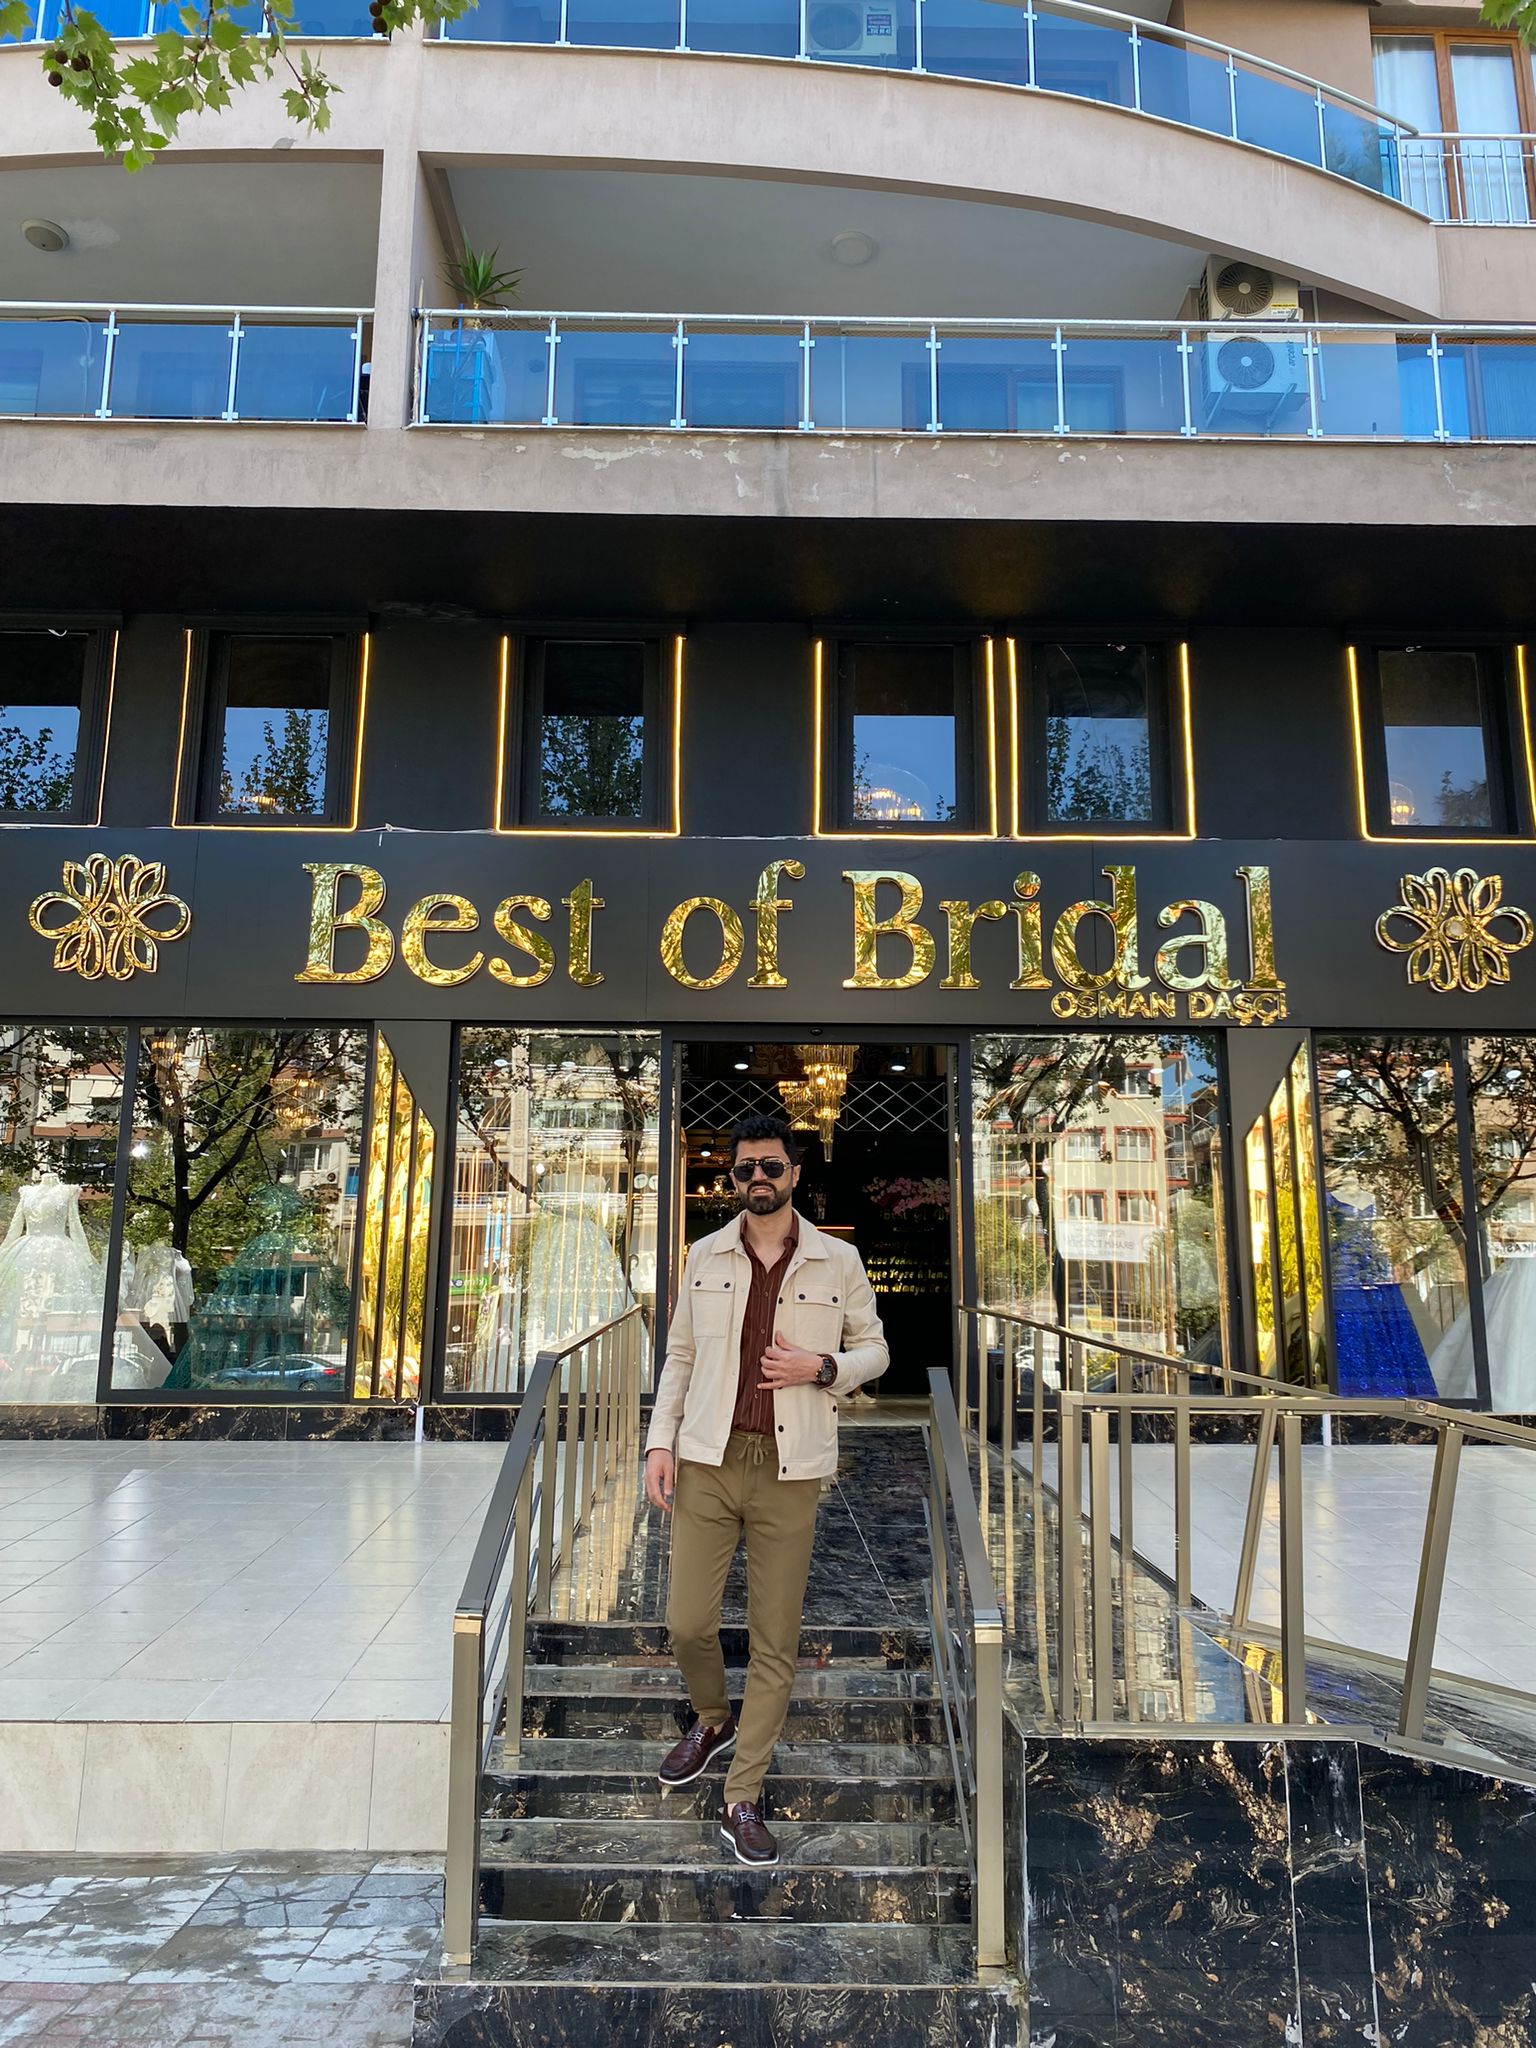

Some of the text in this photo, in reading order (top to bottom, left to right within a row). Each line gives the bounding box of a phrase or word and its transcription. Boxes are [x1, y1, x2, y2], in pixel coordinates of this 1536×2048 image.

[294, 858, 1286, 991] Best of Bridal
[1051, 991, 1288, 1026] OSMAN DAŞÇI
